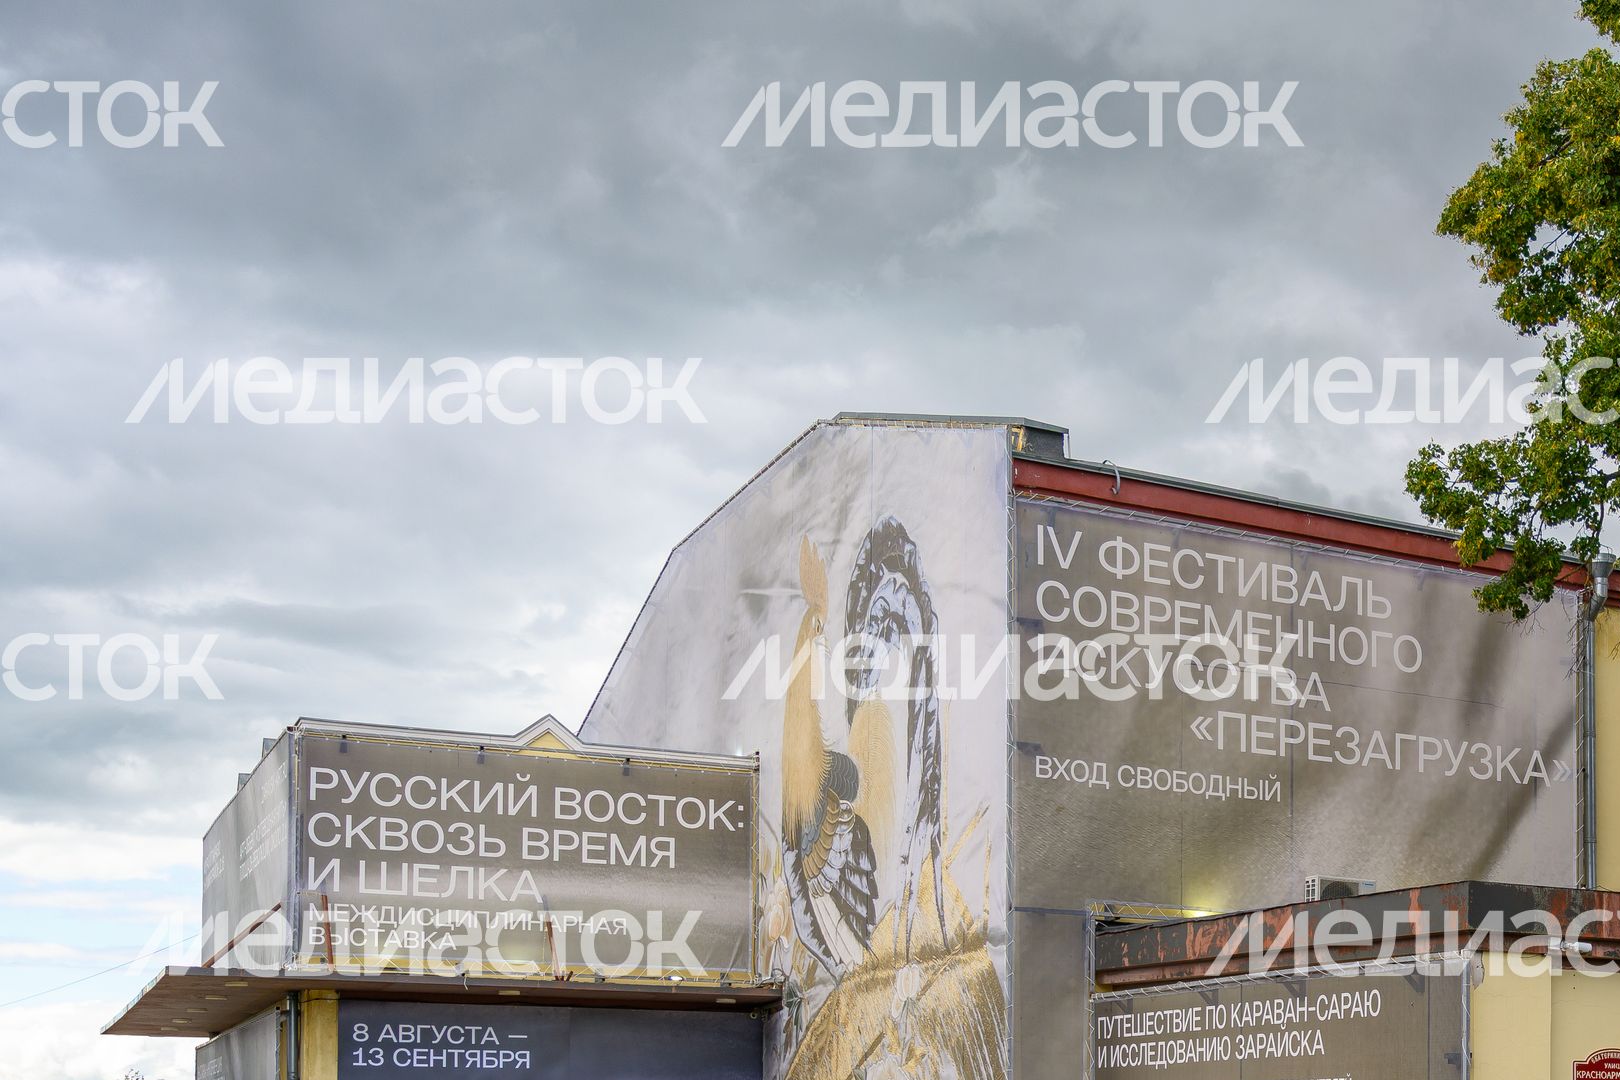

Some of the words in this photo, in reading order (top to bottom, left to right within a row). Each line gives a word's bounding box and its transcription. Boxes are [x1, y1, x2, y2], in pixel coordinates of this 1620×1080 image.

[1036, 524, 1083, 571] IV
[1098, 535, 1393, 620] ФЕСТИВАЛЬ
[1036, 580, 1424, 674] СОВРЕМЕННОГО
[1036, 634, 1331, 712] ИСКУССТВА
[1190, 711, 1571, 788] «ПЕРЕЗАГРУЗКА»
[308, 766, 538, 818] РУССКИЙ
[555, 786, 746, 832] ВОСТОК:
[1035, 756, 1110, 789] ВХОД
[1117, 763, 1282, 803] СВОБОДНЫЙ
[307, 813, 506, 859] СКВОЗЬ
[522, 828, 676, 869] ВРЕМЯ
[308, 857, 340, 892] И
[359, 860, 542, 904] ШЕЛКА
[308, 903, 627, 937] МЕЖДИСЦИПЛИНАРНАЯ
[308, 926, 457, 952] ВЫСТАВКА
[352, 1023, 369, 1042] 8
[378, 1023, 500, 1045] АВГУСТА
[1097, 1007, 1202, 1040] ПУТЕШЕСТВИЕ
[1205, 1004, 1226, 1031] ПО
[1231, 989, 1382, 1027] КАРАВАН-САРАЮ
[352, 1047, 384, 1066] 13
[393, 1047, 530, 1069] СЕНТЯБРЯ
[1098, 1045, 1107, 1068] И
[1111, 1035, 1231, 1069] ИССЛЕДОВАНИЮ
[1235, 1023, 1325, 1058] ЗАРАЙСКА
